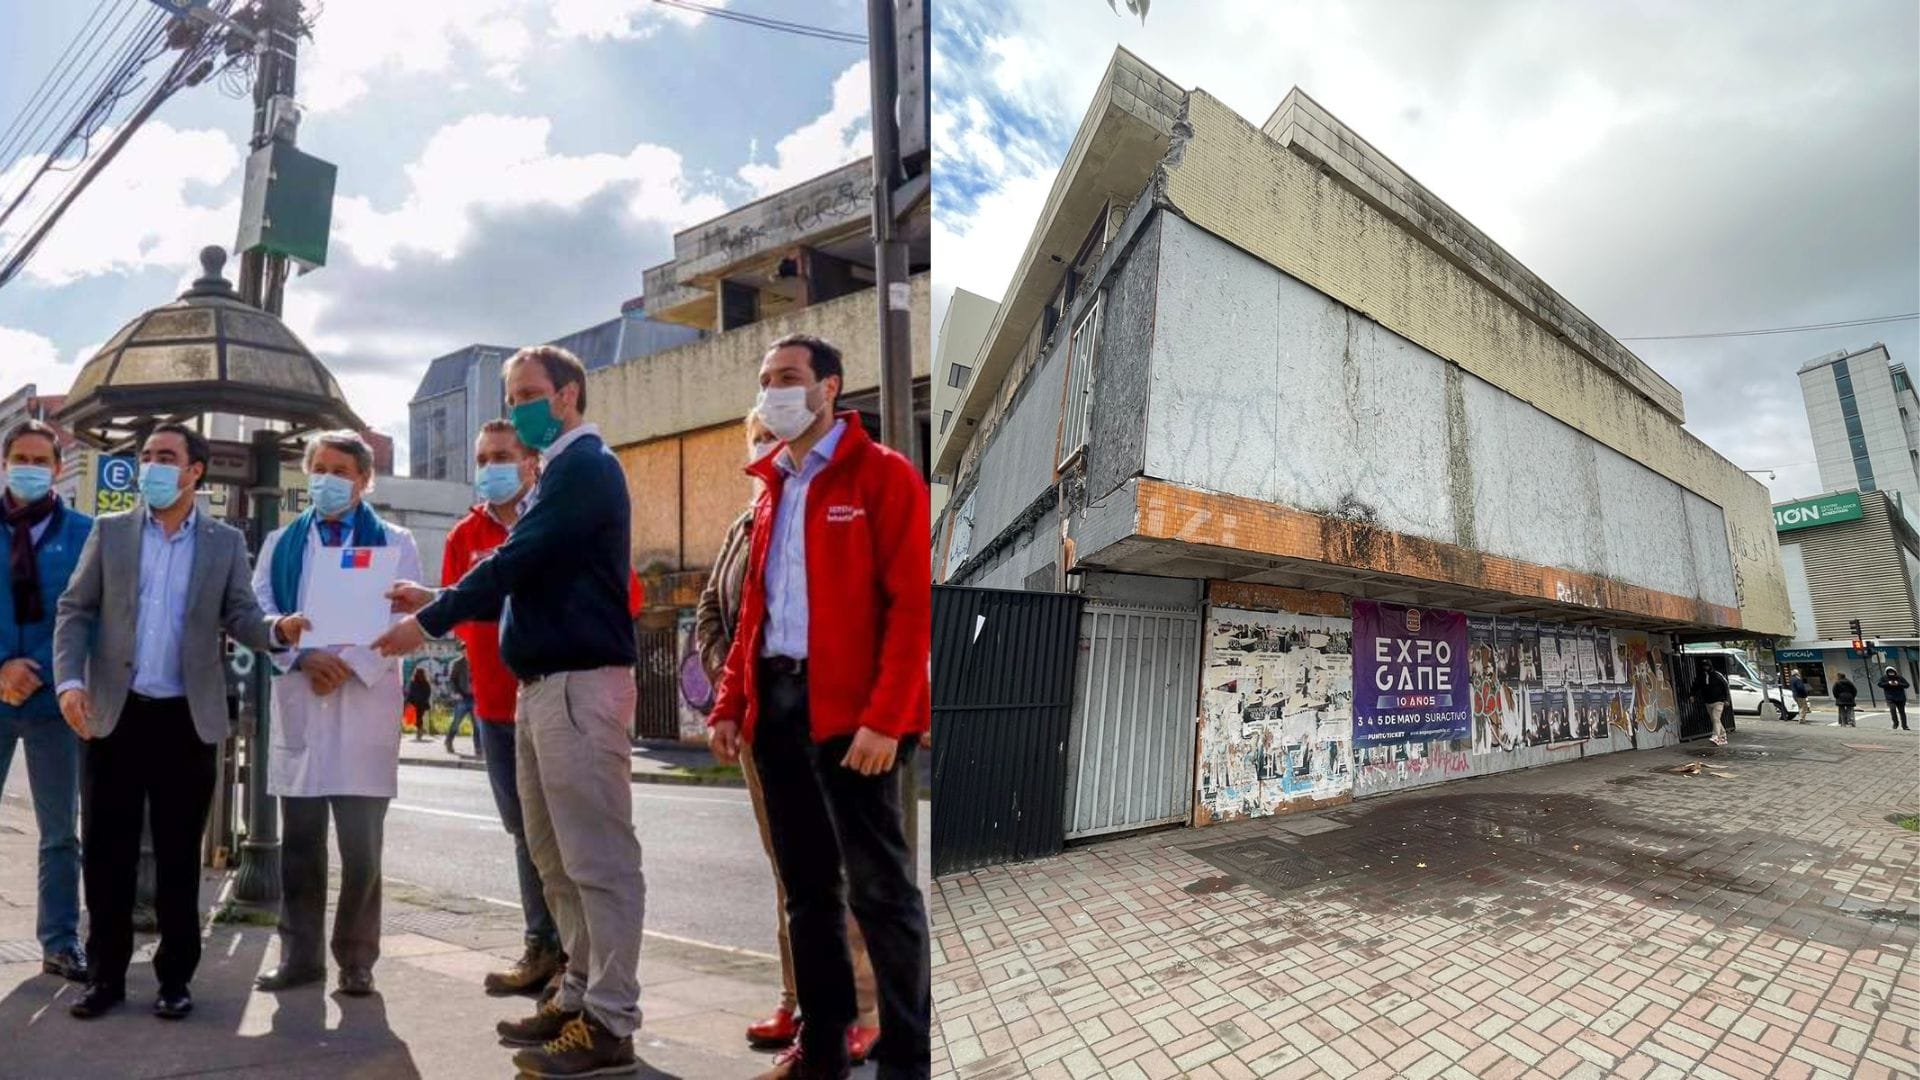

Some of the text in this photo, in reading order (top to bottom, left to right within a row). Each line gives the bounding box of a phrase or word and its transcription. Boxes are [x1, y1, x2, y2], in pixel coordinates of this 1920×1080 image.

[112, 466, 126, 484] E
[1771, 505, 1820, 526] IÓN
[1375, 637, 1451, 664] EXPO
[1375, 665, 1452, 691] GAME
[1396, 697, 1407, 707] 10
[1357, 711, 1467, 727] 3 4 5 DE MAYO SURACTIVO
